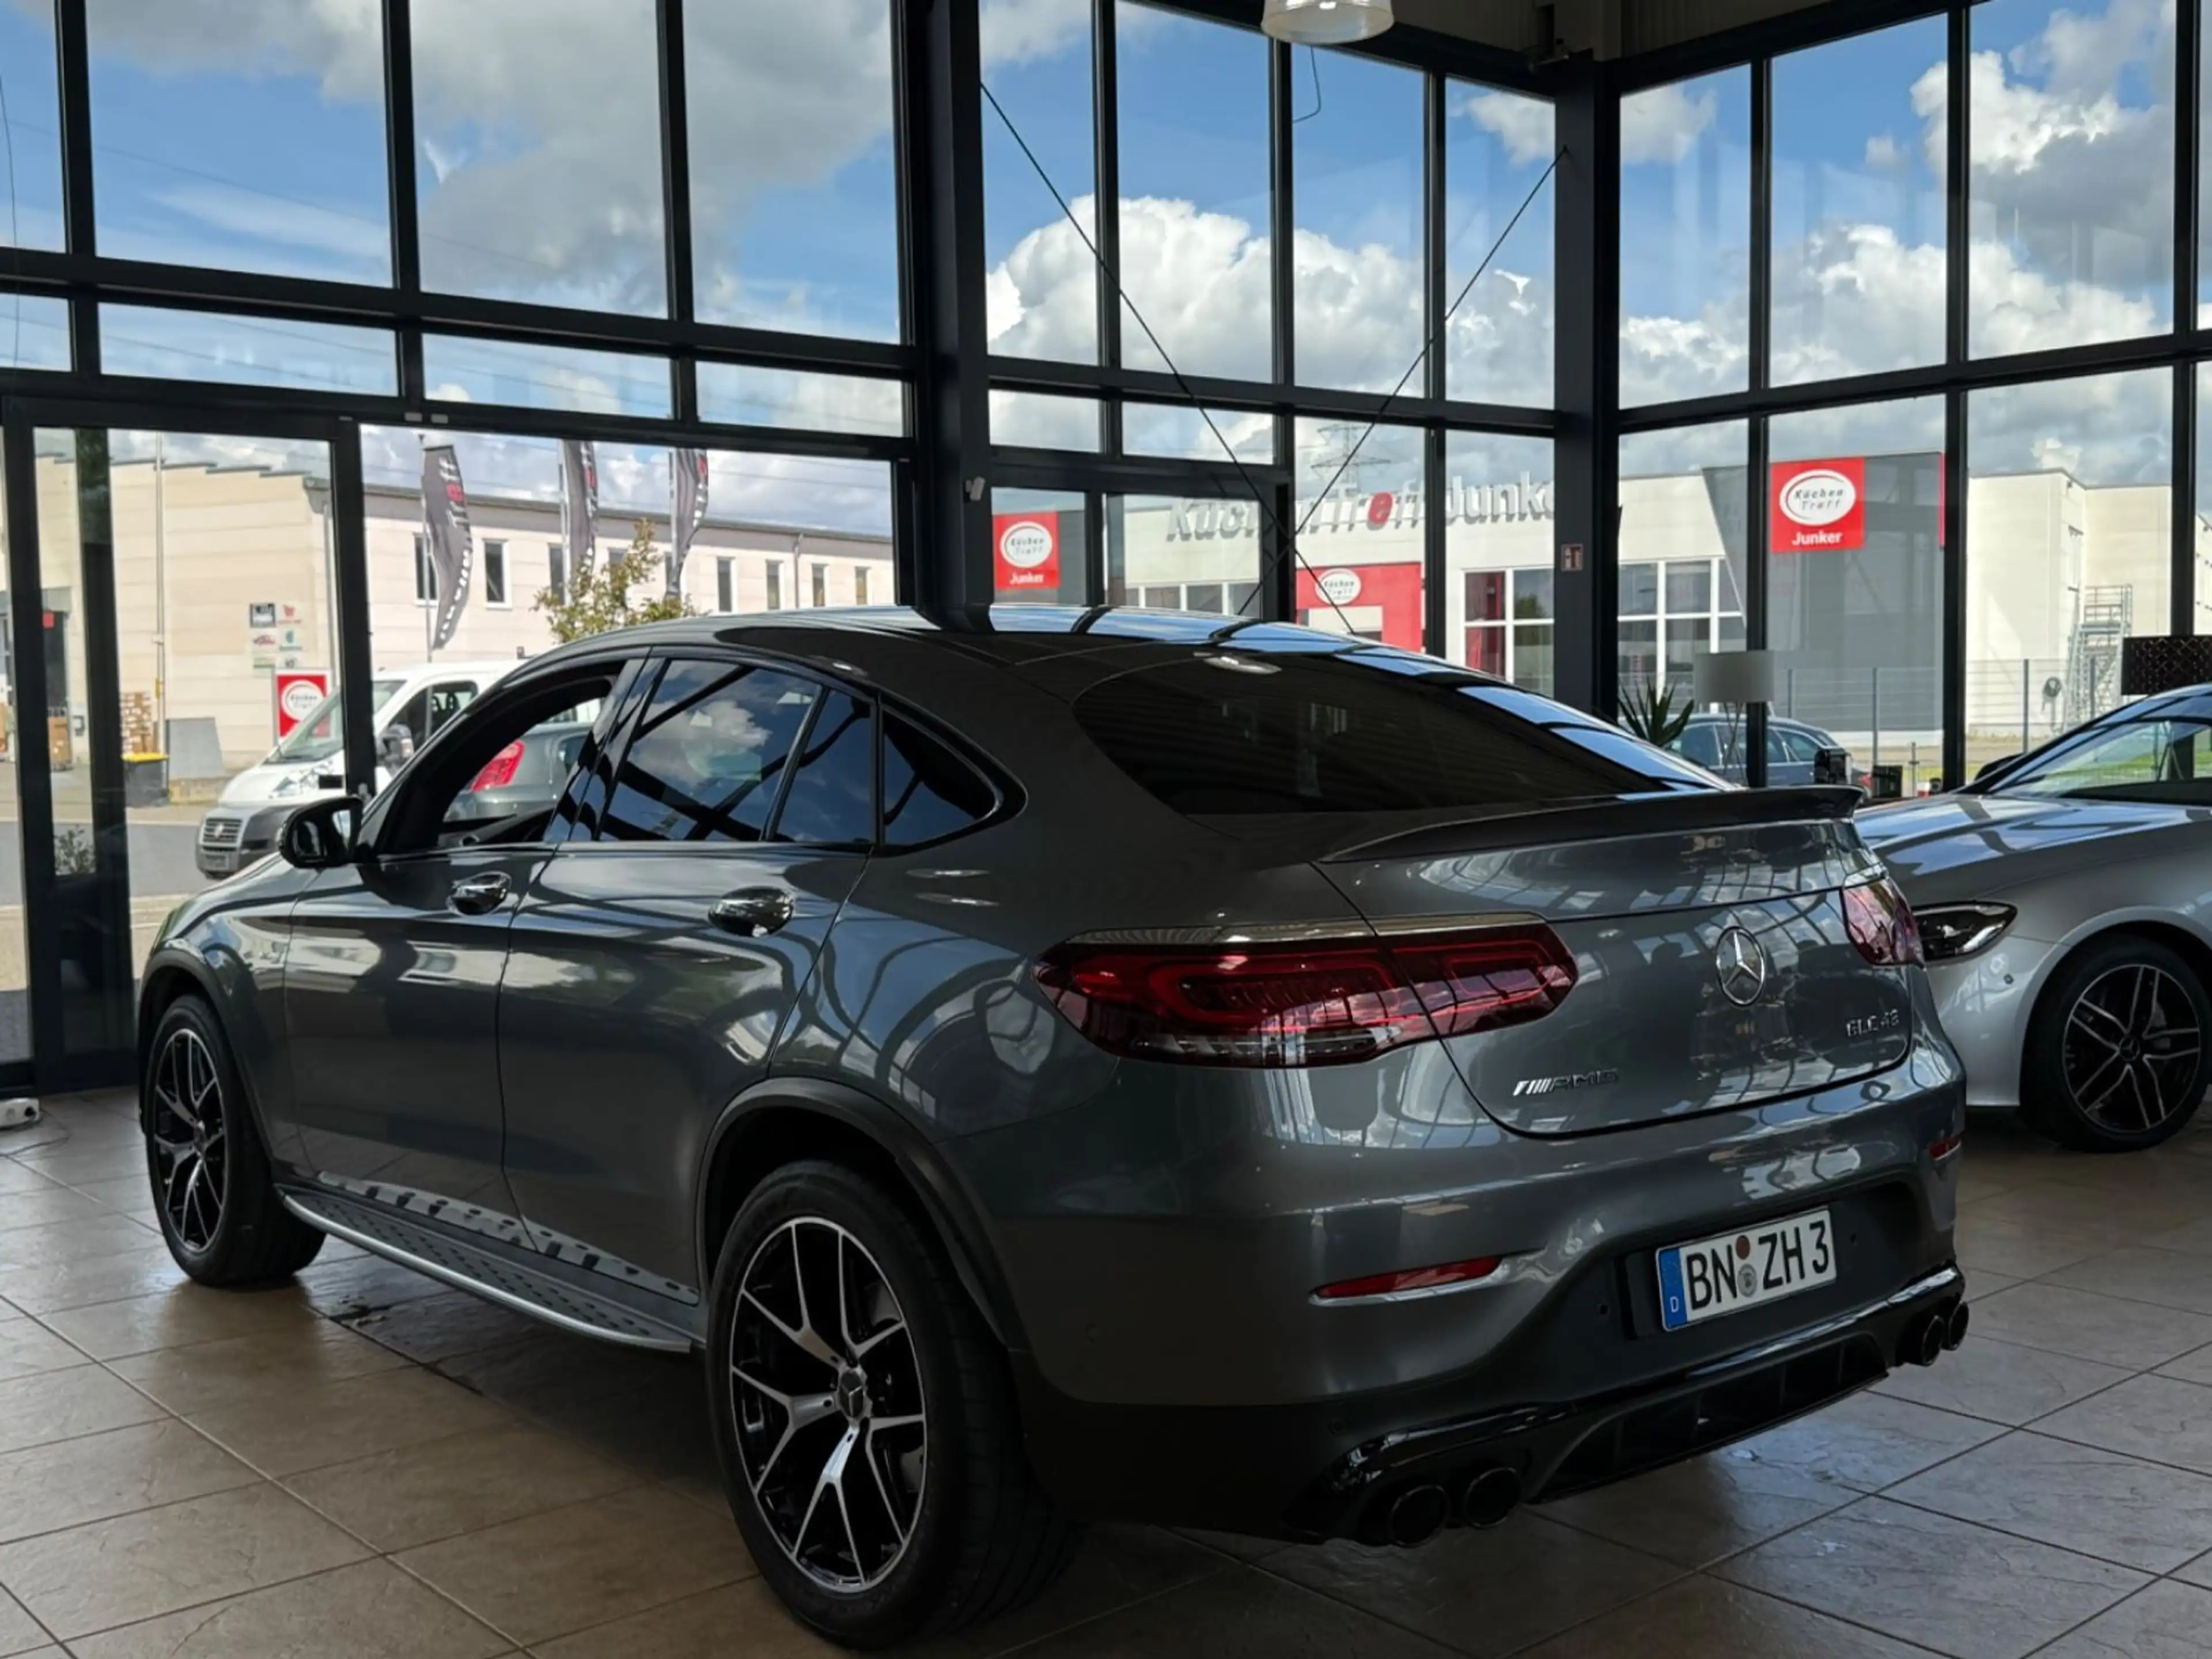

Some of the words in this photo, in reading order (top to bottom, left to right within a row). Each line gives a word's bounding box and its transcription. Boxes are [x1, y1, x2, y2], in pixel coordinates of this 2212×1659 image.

[1791, 529, 1843, 546] Junker
[1009, 571, 1044, 585] Junker
[1686, 1244, 1737, 1310] BN
[1758, 1226, 1805, 1290] ZH
[1809, 1219, 1829, 1274] 3
[1670, 1296, 1679, 1313] D
